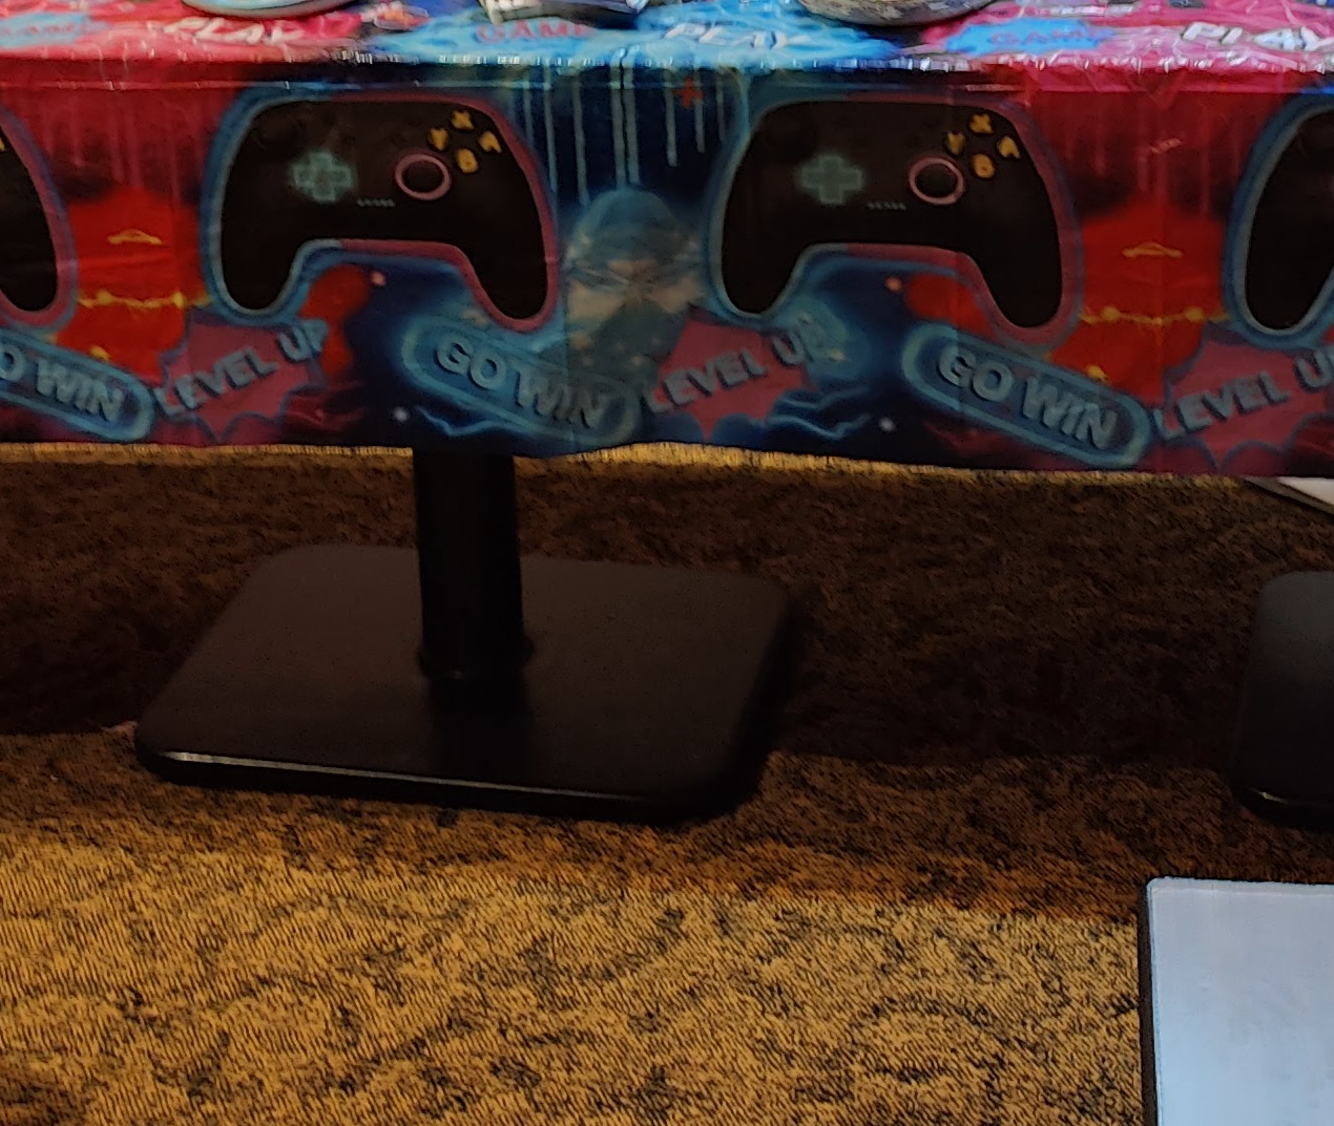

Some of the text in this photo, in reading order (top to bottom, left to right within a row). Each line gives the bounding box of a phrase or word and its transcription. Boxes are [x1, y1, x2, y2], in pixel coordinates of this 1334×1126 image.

[33, 356, 129, 423] WIN
[154, 317, 330, 419] LEVEL UP
[434, 337, 607, 429] GO WIN
[642, 348, 767, 414] LEVEL
[936, 345, 1120, 451] GO WIN
[1152, 375, 1292, 442] LEVEL
